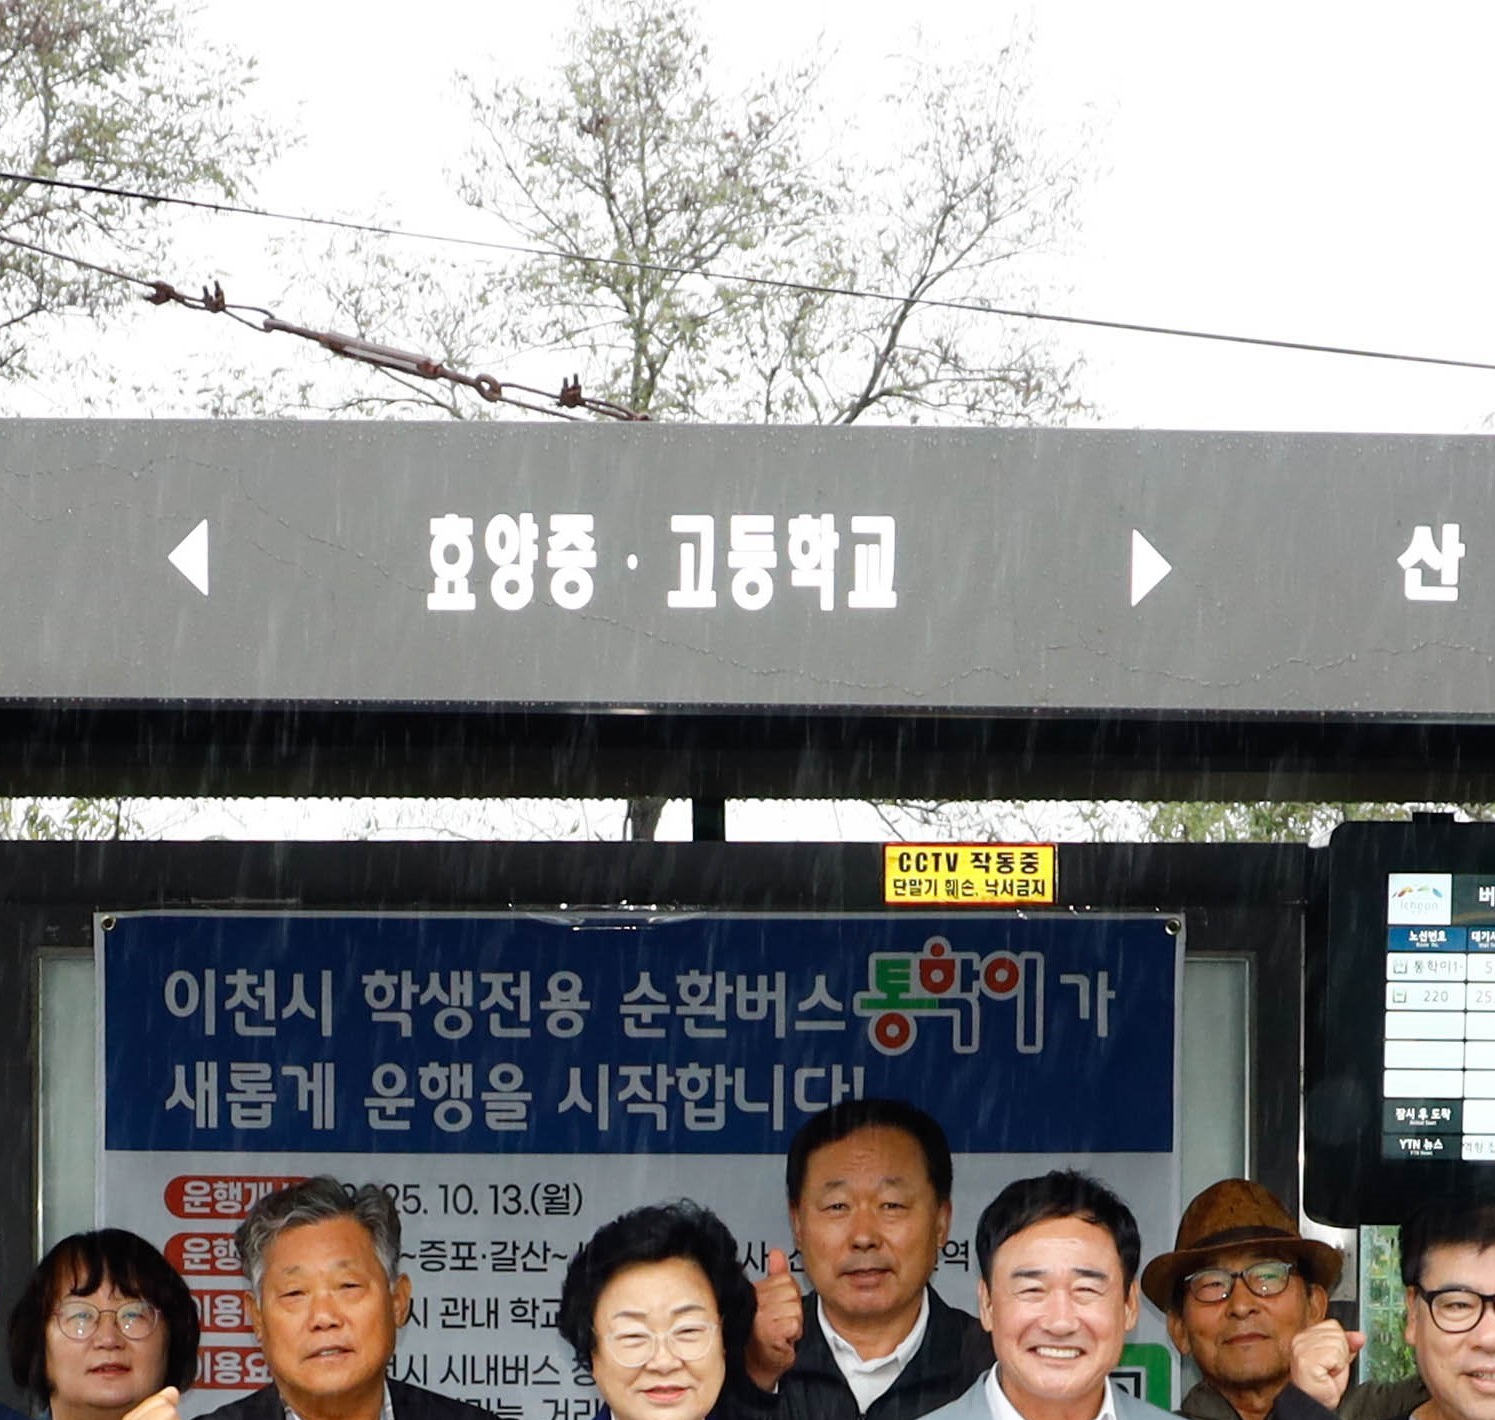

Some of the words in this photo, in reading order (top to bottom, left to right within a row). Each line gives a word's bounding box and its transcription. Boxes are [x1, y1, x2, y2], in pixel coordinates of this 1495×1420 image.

[898, 852, 959, 873] CCTV
[970, 852, 1040, 875] 작동중
[892, 878, 938, 897] 단말기
[985, 878, 1046, 897] 낙서금지
[164, 969, 334, 1038] 이천시
[362, 969, 592, 1038] 학생전용
[618, 969, 848, 1038] 순환버스
[1061, 970, 1117, 1039] 가
[1423, 990, 1449, 1004] 220
[164, 1063, 335, 1134] 새롭게
[361, 1063, 528, 1134] 운행을
[1399, 1138, 1420, 1150] YTN
[1422, 1138, 1444, 1151] 뉴스
[439, 1183, 479, 1215] 10.
[489, 1184, 584, 1217] 13.(월)
[439, 1297, 499, 1329] 관내
[439, 1354, 561, 1386] 시내버스
